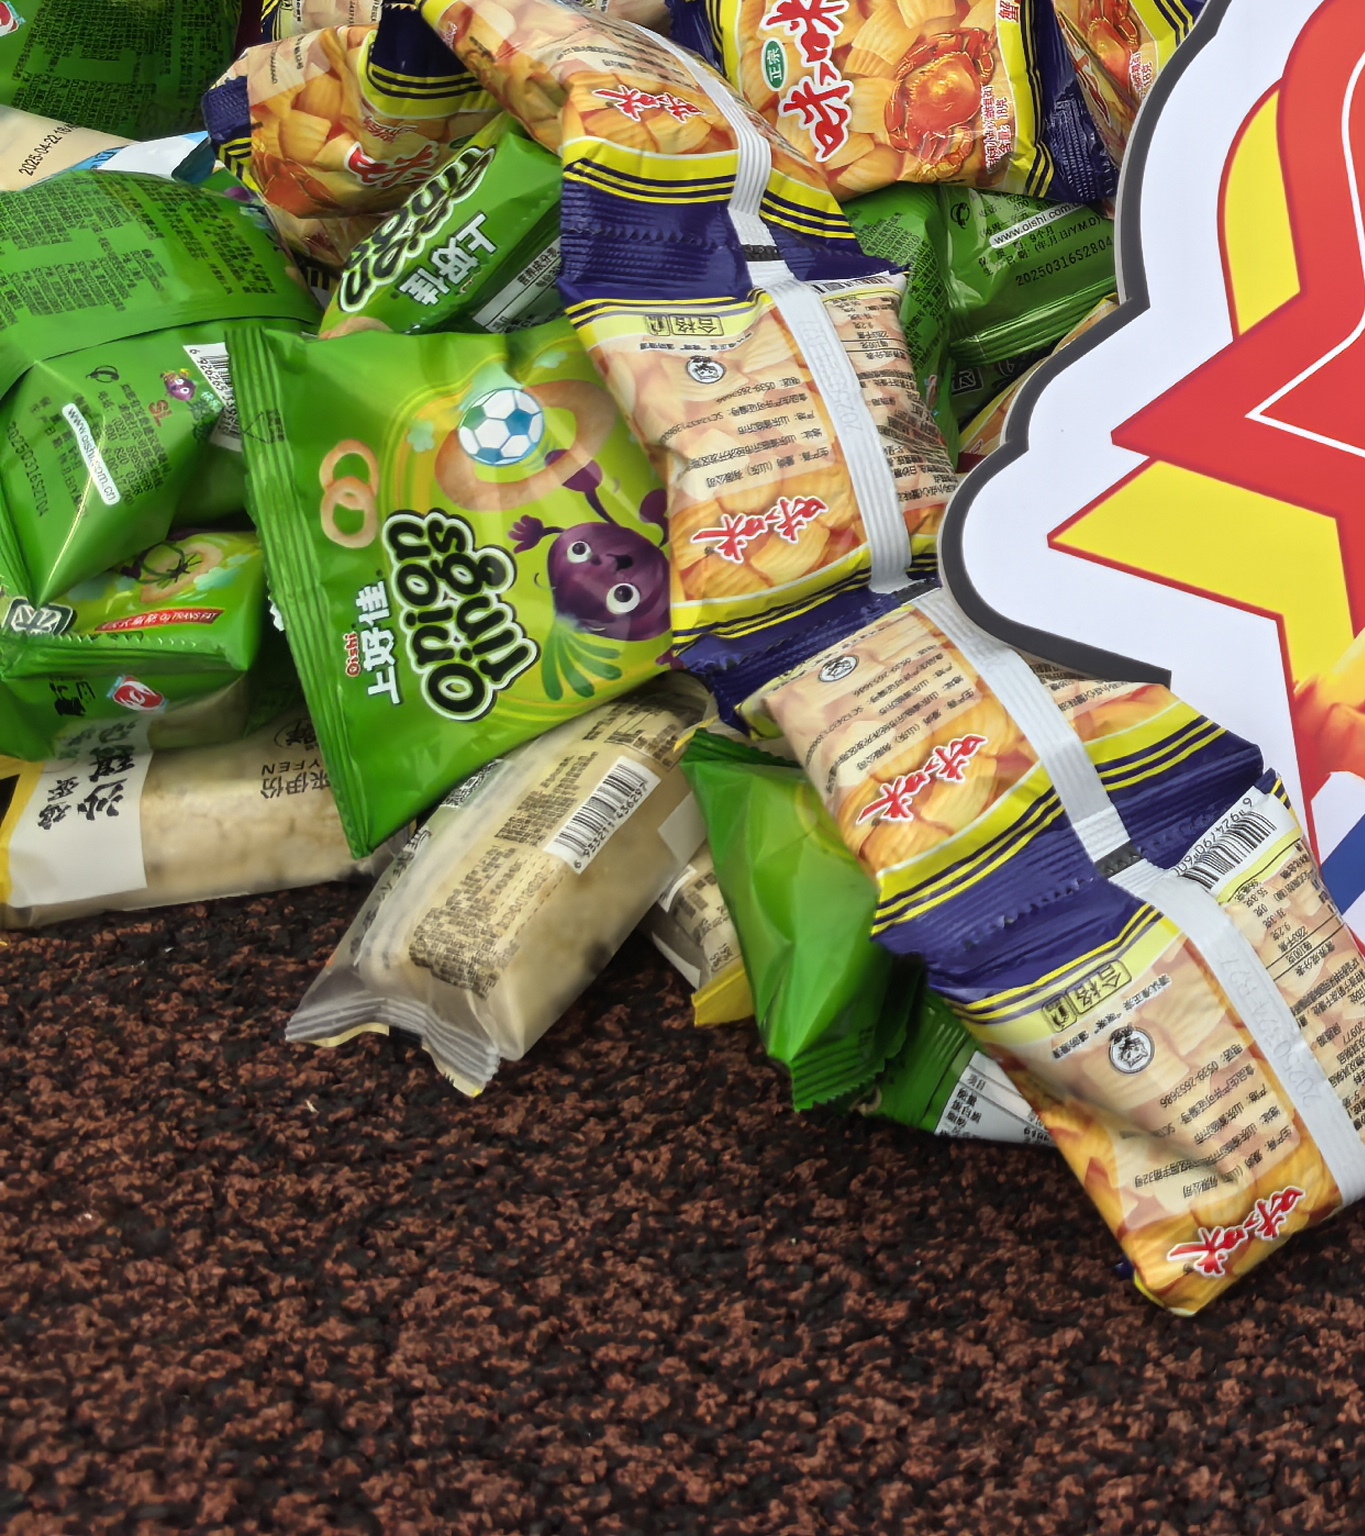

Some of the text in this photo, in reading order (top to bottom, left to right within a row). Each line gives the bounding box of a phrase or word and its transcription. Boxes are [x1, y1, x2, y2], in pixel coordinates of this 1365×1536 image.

[761, 38, 785, 92] 正宗
[396, 203, 509, 320] 上好佳
[673, 316, 716, 335] 合格
[146, 395, 176, 428] SL
[692, 495, 830, 563] 咪咪
[381, 512, 491, 721] Onion
[427, 512, 539, 690] rings
[347, 631, 358, 675] Oishi
[359, 579, 400, 703] 上好佳
[857, 733, 989, 825] 咪咪
[1268, 918, 1292, 943] 9.2克
[1068, 959, 1128, 1011] 合格
[1338, 1018, 1365, 1047] 20977
[1153, 1040, 1247, 1109] 电话：0539-2653686
[1166, 1187, 1304, 1276] 咪咪
